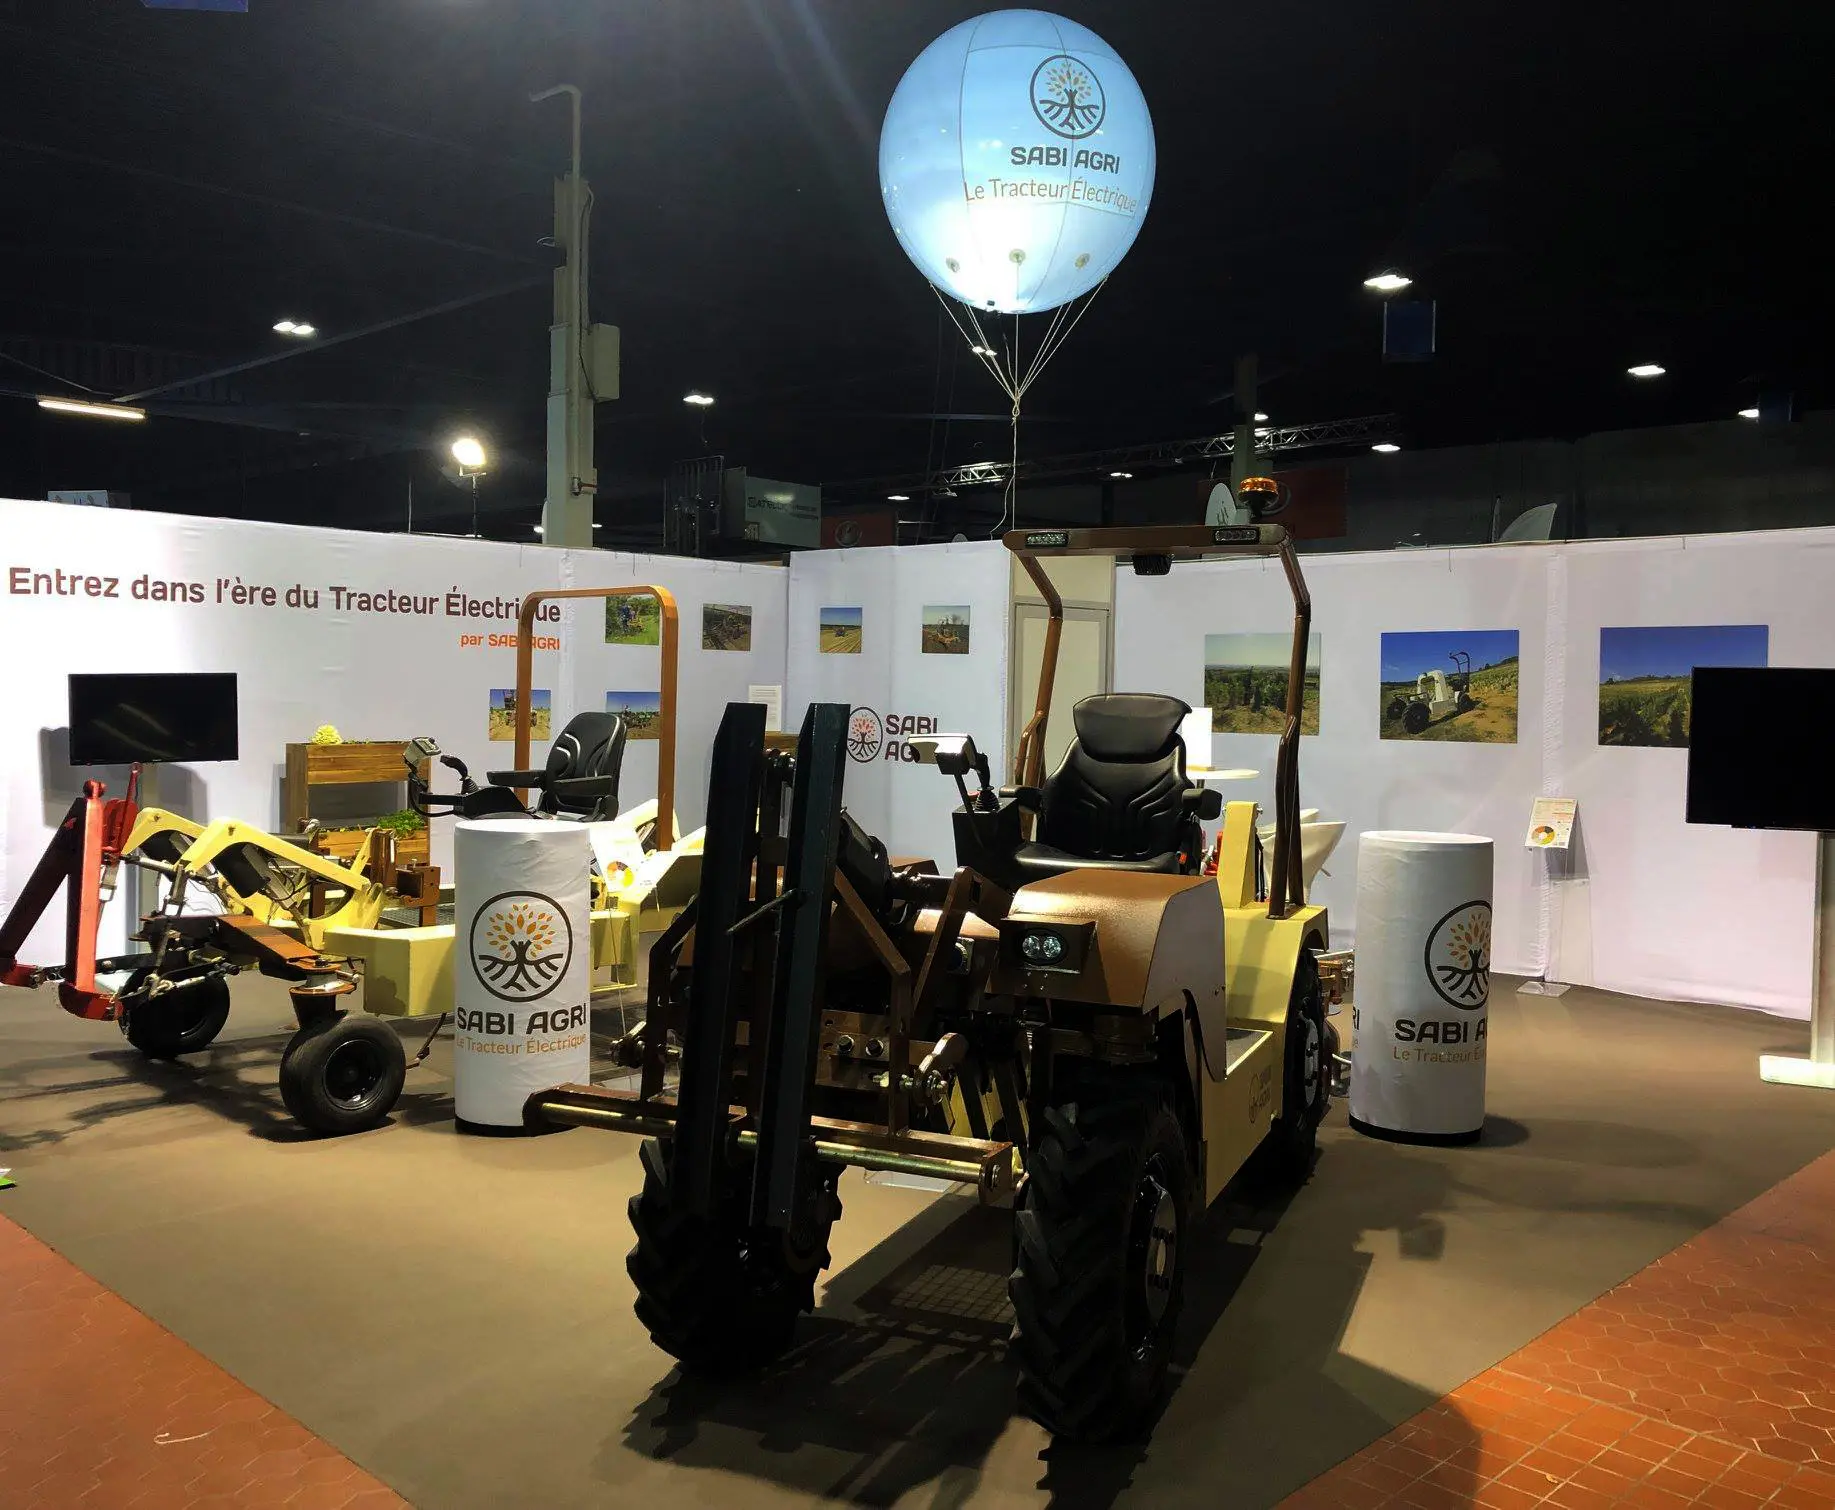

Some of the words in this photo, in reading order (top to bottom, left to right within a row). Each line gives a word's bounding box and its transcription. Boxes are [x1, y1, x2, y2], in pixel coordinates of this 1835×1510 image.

[1010, 146, 1068, 168] SABI
[1073, 149, 1120, 175] AGRI
[963, 181, 985, 202] Le
[988, 178, 1070, 200] Tracteur
[1071, 176, 1138, 214] Électrique
[9, 566, 119, 598] Entrez
[131, 573, 205, 604] dans
[285, 581, 319, 608] du
[329, 585, 439, 616] Tracteur
[445, 585, 561, 623] Électriue
[460, 634, 484, 648] par
[884, 714, 938, 736] SABI
[456, 1005, 514, 1035] SABI
[525, 1002, 587, 1036] AGRI
[1394, 1018, 1467, 1044] SABI
[466, 1036, 521, 1055] Tracteur
[526, 1032, 587, 1055] Électrique
[1392, 1045, 1410, 1061] Le
[1414, 1048, 1472, 1064] Tracteur
